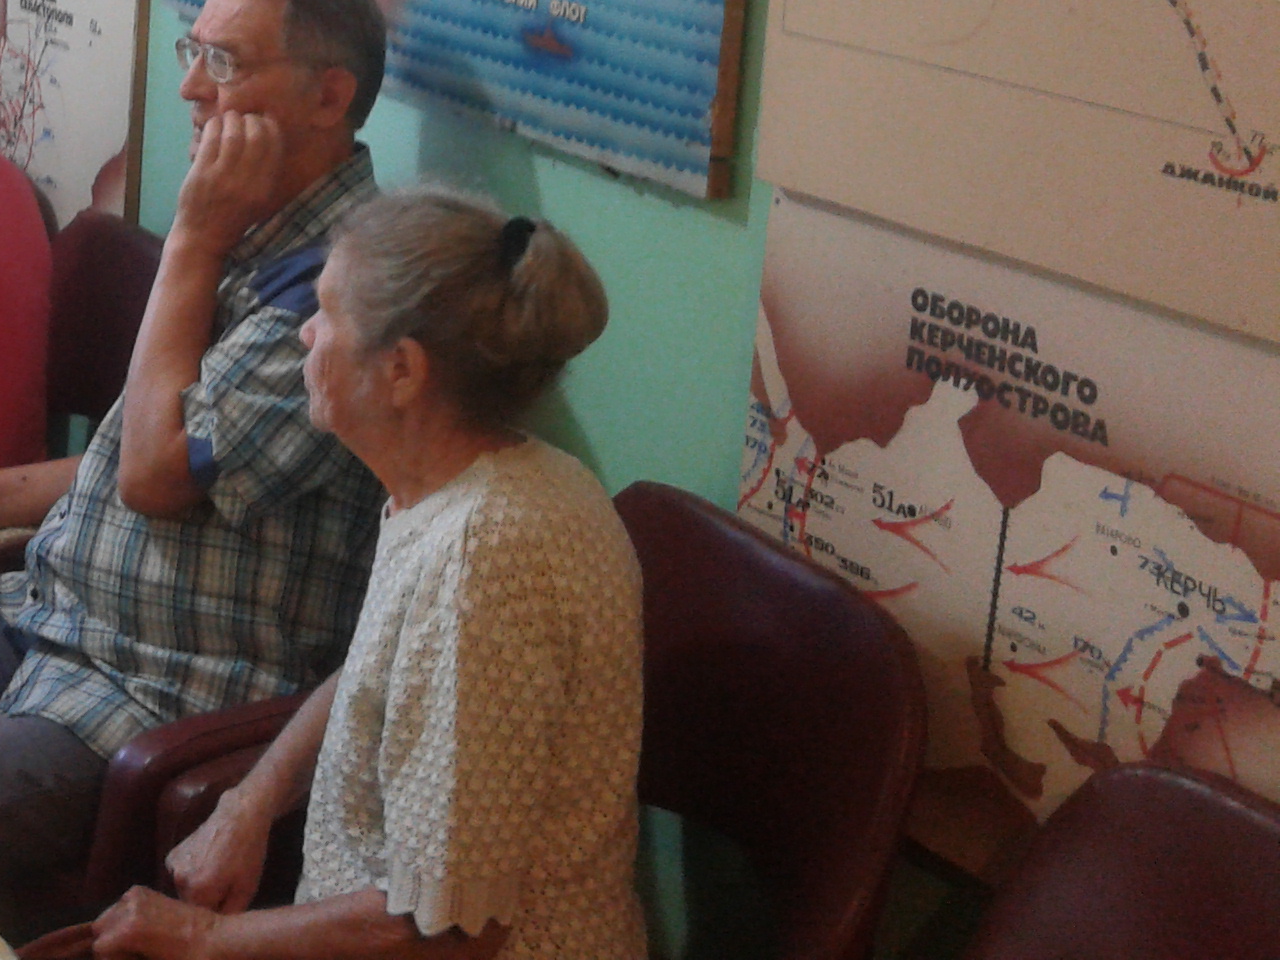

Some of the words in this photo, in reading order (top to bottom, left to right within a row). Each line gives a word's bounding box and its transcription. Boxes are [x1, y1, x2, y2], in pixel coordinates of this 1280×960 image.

[911, 287, 1039, 354] ОБОРОНА
[905, 346, 1109, 447] ПОЛУОСТРОВА
[908, 319, 1099, 406] КЕРЧЕНСКОГО
[1155, 566, 1227, 616] КЕРЧЬ
